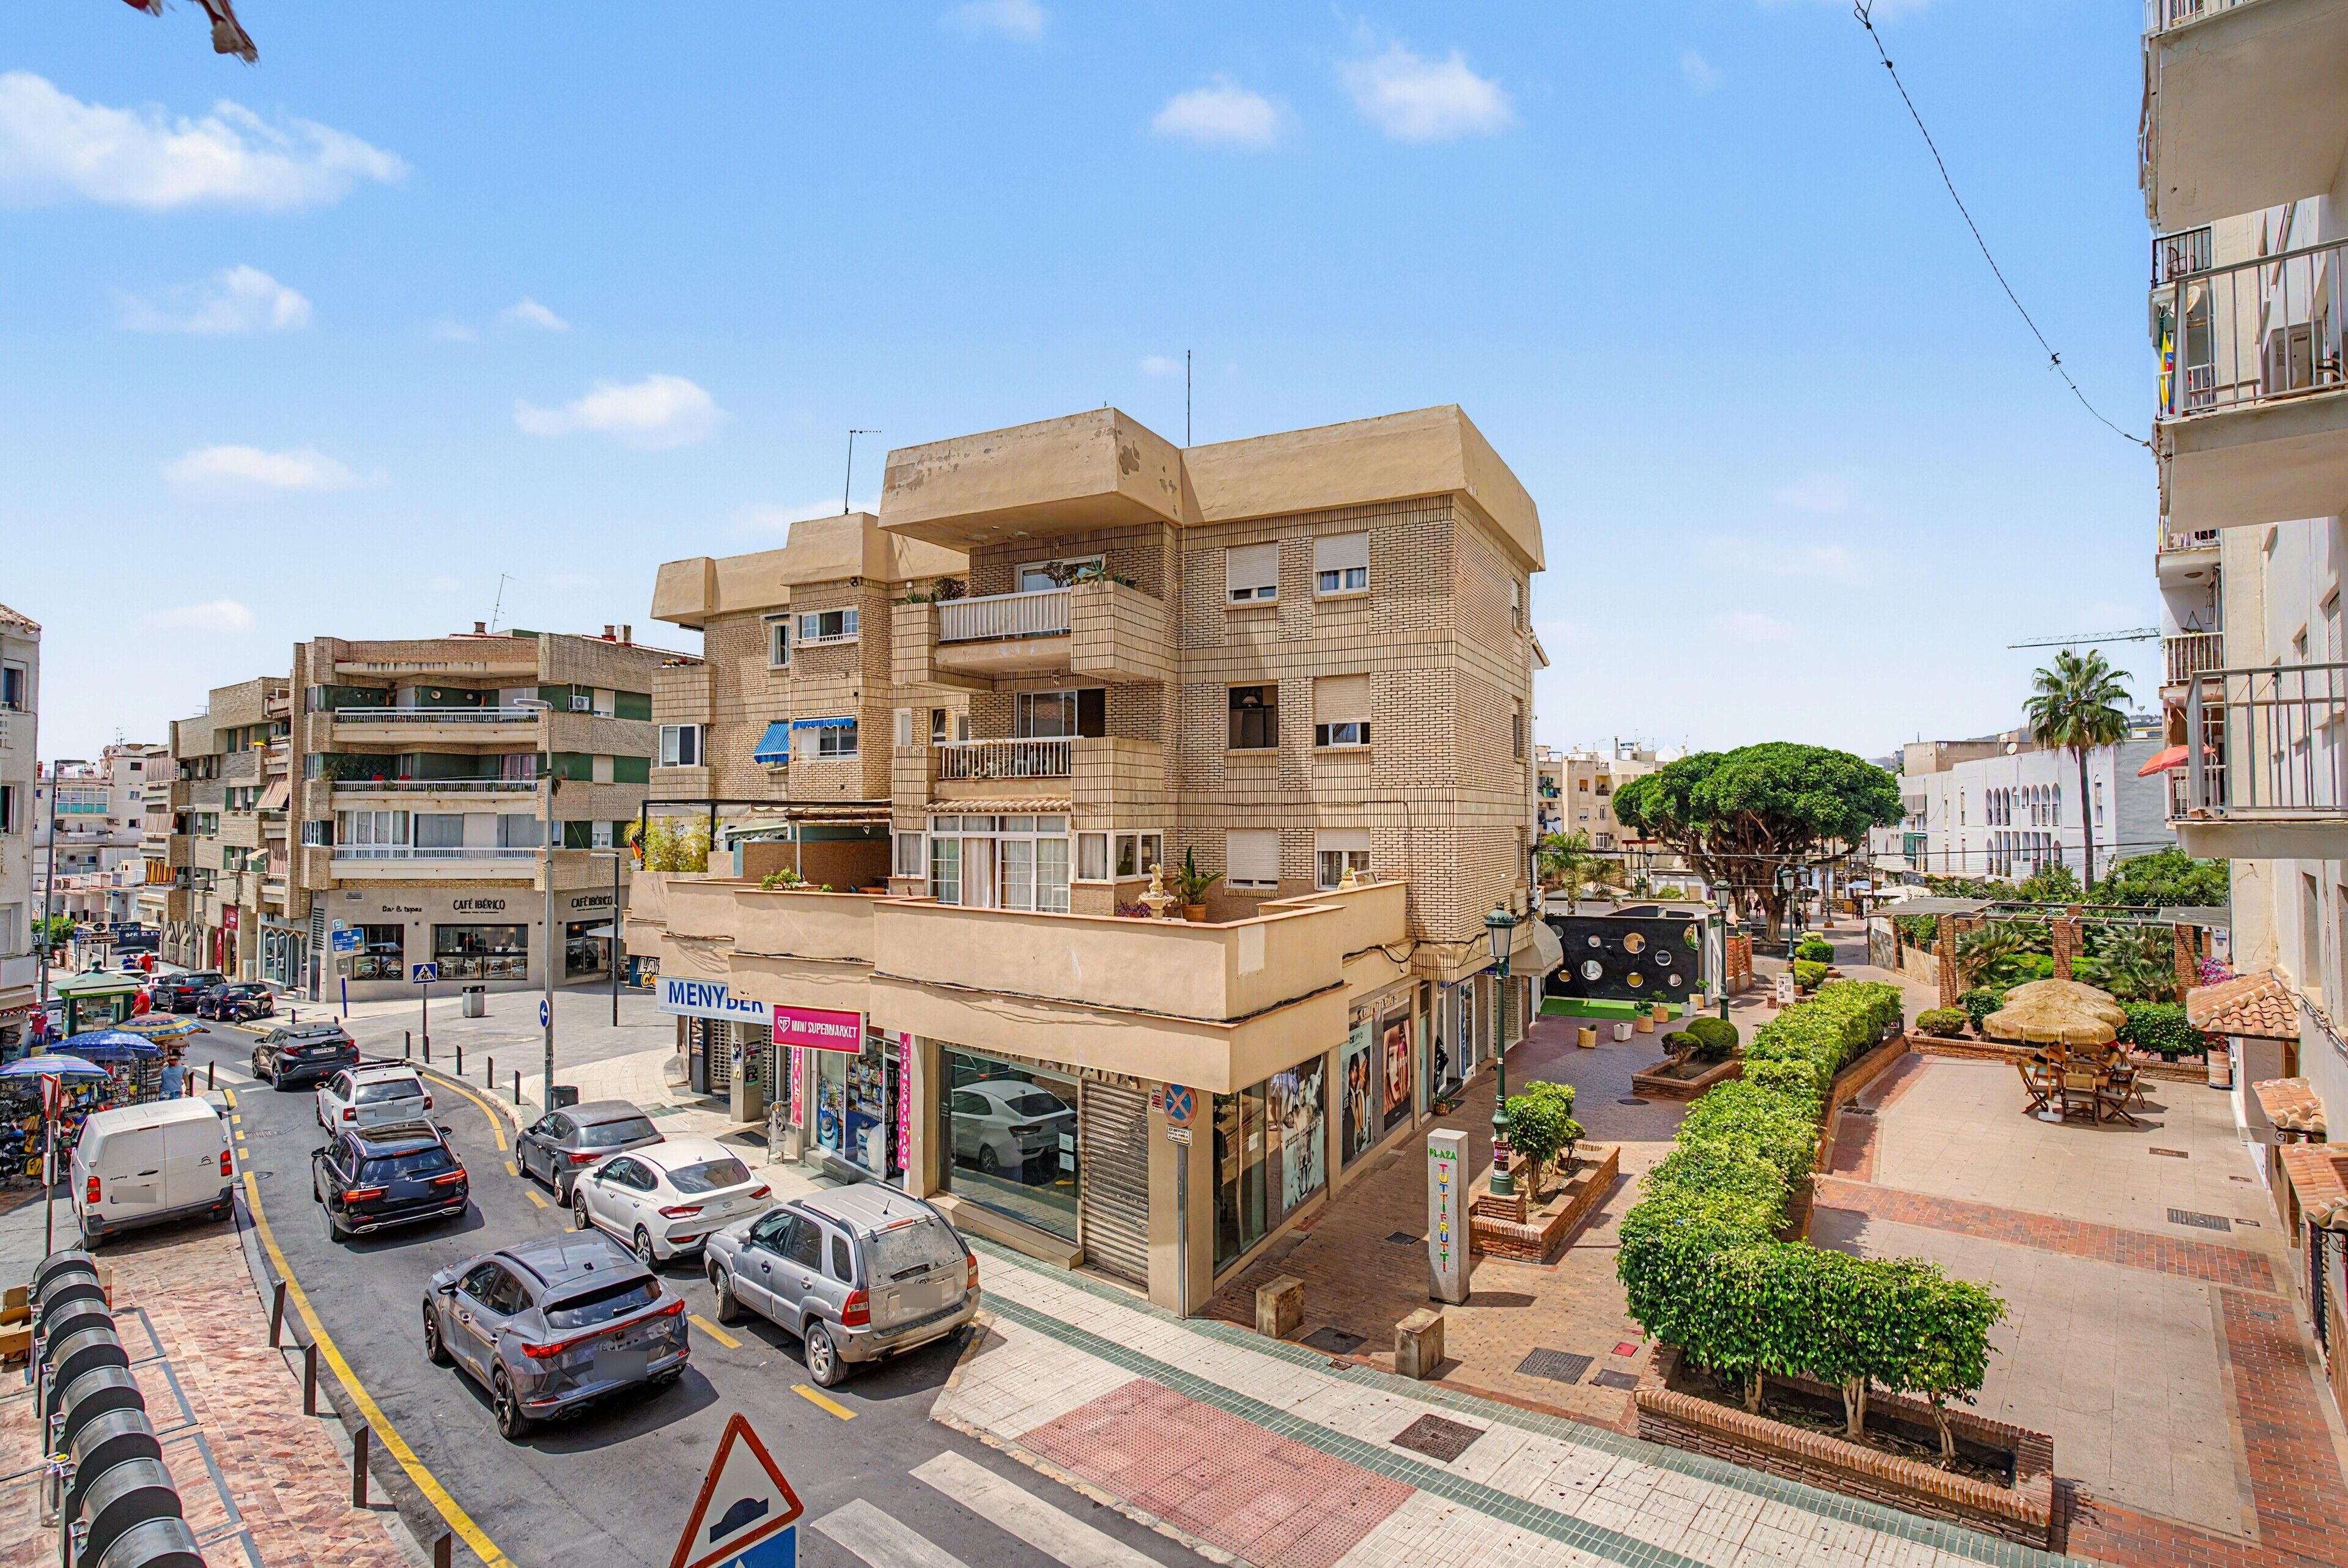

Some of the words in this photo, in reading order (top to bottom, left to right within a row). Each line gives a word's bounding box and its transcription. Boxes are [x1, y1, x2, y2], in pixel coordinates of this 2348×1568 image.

[452, 897, 473, 910] CAFÉ
[474, 898, 506, 910] IBÉRICO
[791, 1020, 807, 1032] MINI
[807, 1021, 858, 1039] SUPERMARKET
[1428, 1147, 1457, 1160] PLAZA
